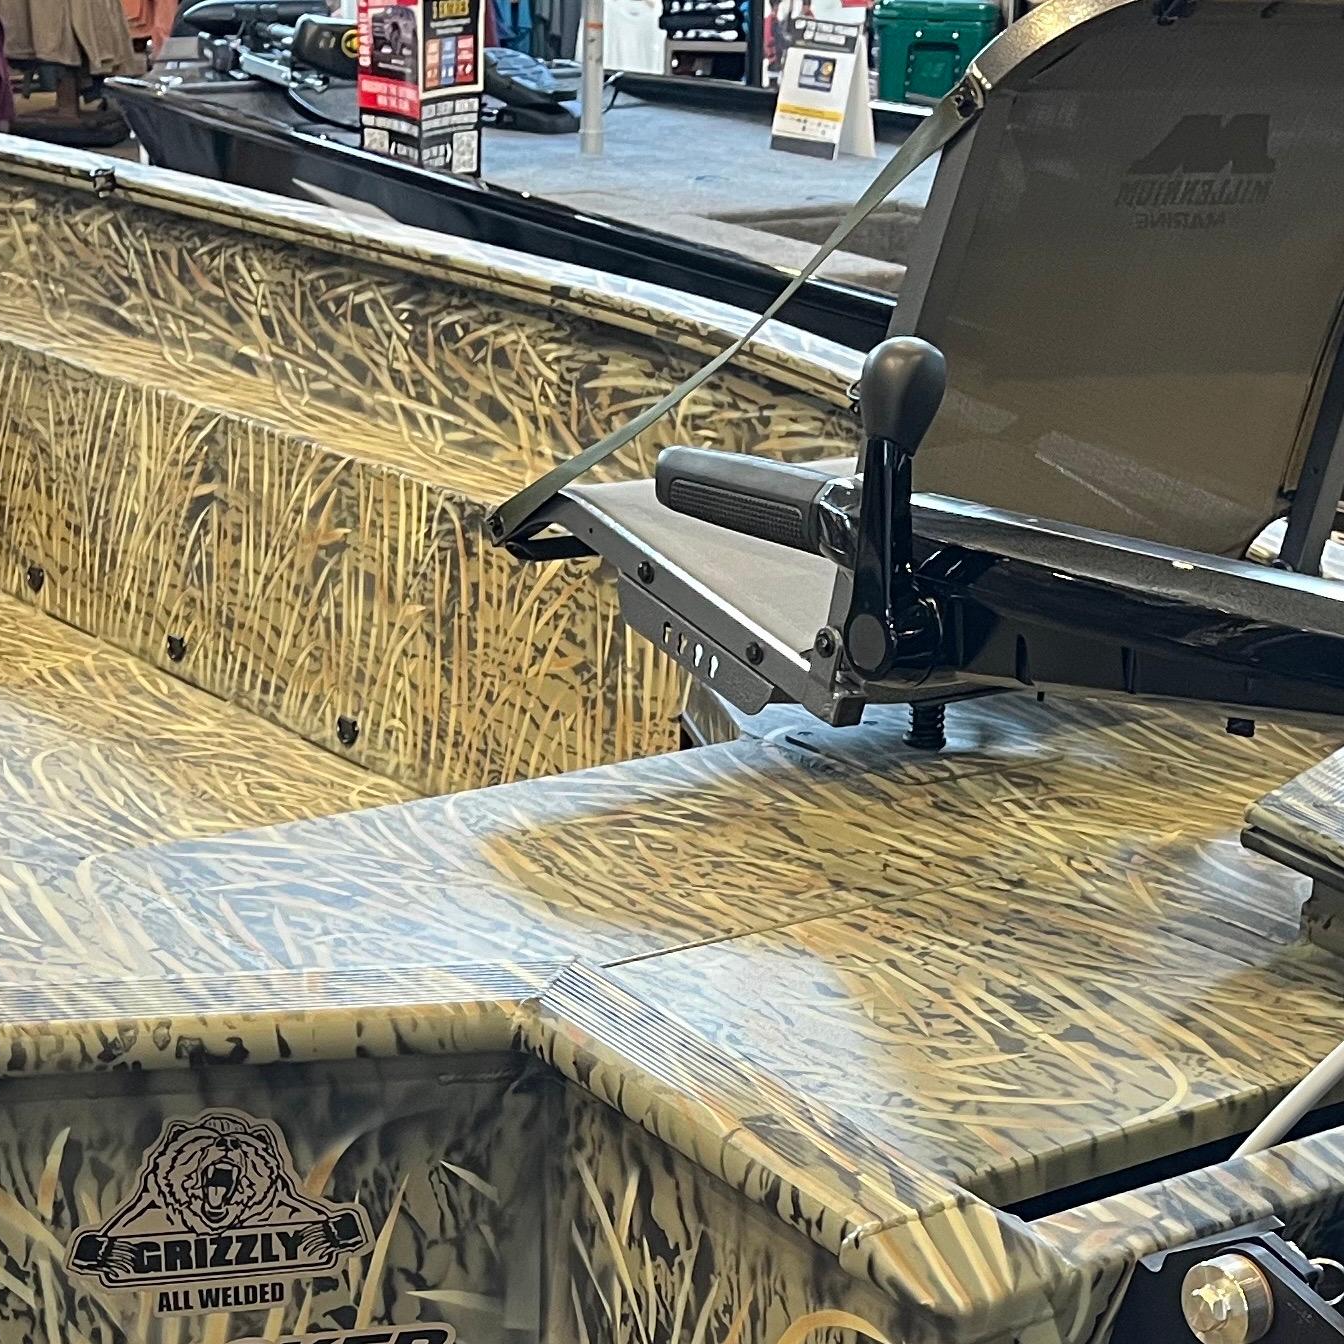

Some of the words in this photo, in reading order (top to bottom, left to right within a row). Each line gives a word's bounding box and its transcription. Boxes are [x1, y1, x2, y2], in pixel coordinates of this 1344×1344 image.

[133, 1229, 304, 1274] GRIZZLY
[158, 1289, 194, 1312] ALL
[199, 1283, 284, 1309] WELDED
